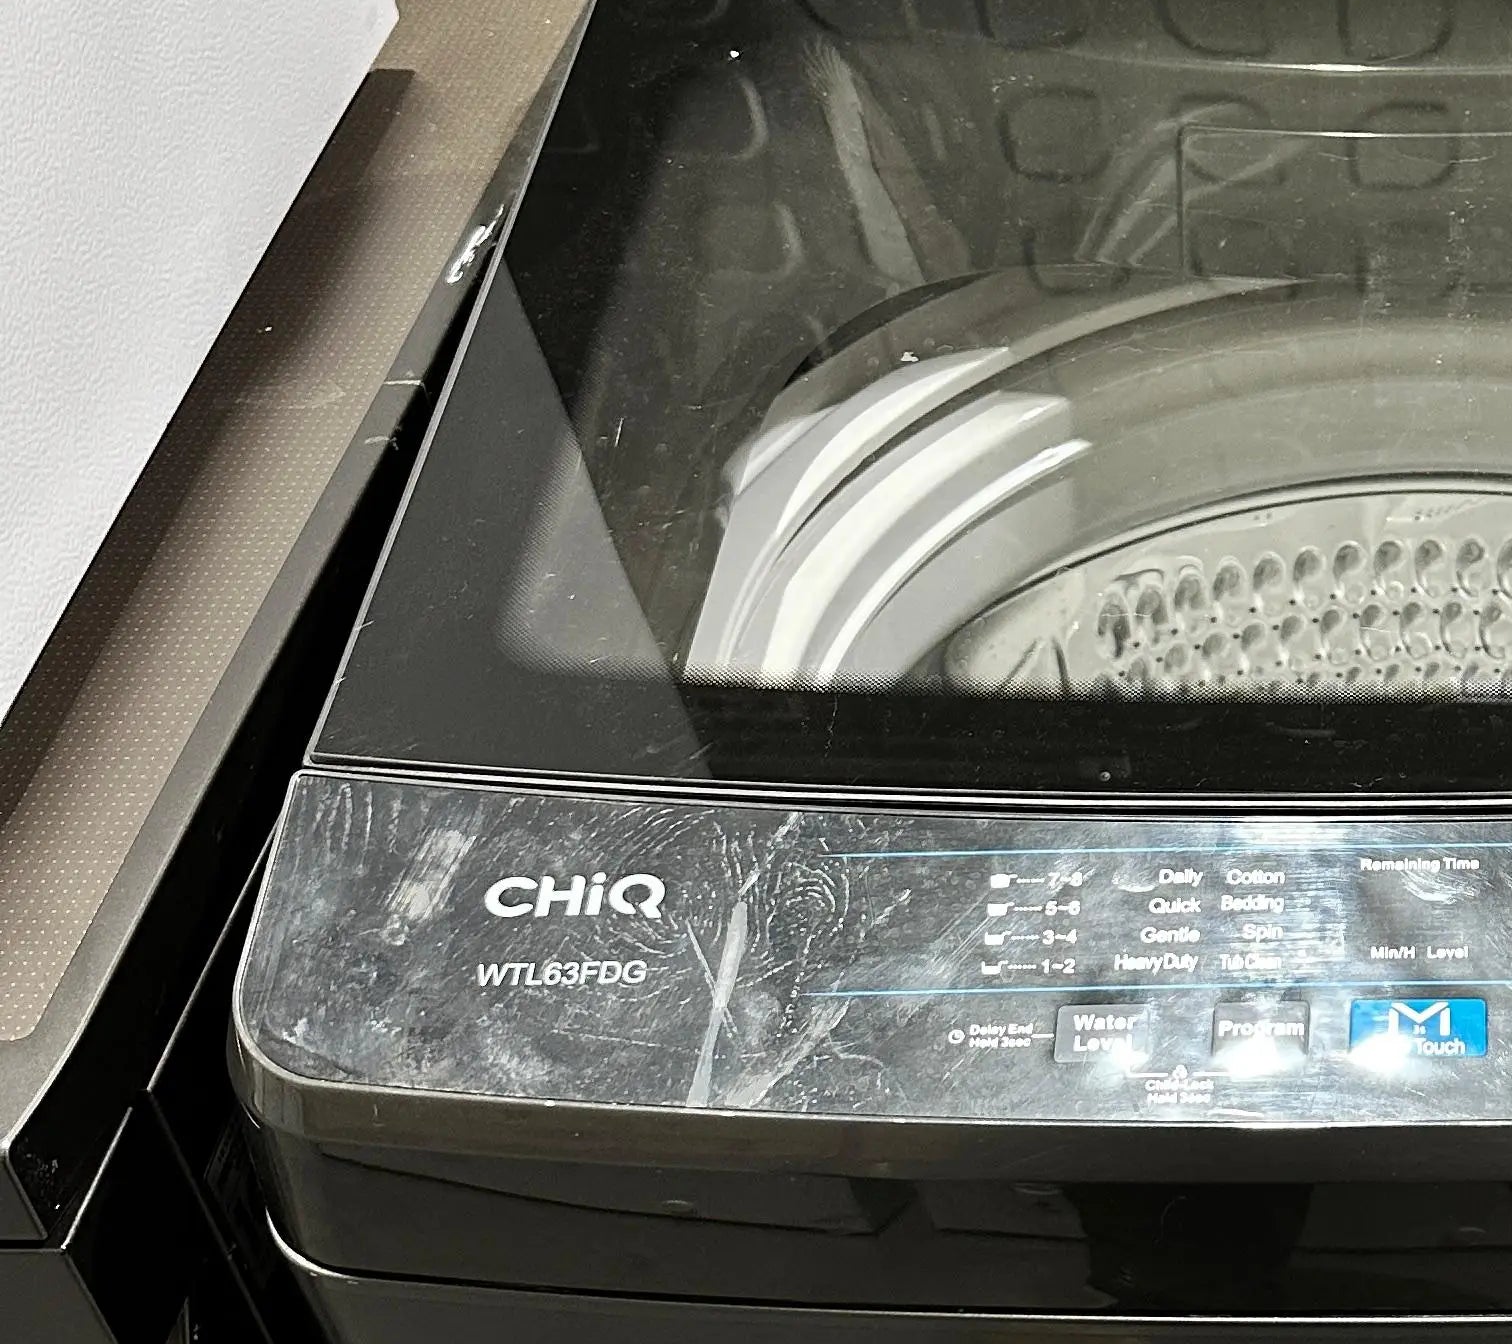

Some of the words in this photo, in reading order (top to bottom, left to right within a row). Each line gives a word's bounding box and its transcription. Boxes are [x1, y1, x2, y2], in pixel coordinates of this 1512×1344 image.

[1360, 857, 1441, 873] Remaining
[1442, 856, 1480, 871] Time
[1159, 868, 1203, 887] Daily
[1226, 869, 1286, 885] Cotton
[484, 871, 666, 918] CHiQ
[1149, 897, 1201, 913] Quick
[1221, 894, 1285, 914] Bedding
[1140, 927, 1200, 943] Gentle
[1242, 923, 1284, 943] Spin
[1426, 945, 1469, 960] Level
[477, 960, 648, 986] WTL63FDG
[969, 1023, 1006, 1037] Delay
[1008, 1023, 1034, 1035] End
[1073, 1014, 1137, 1032] Water
[1218, 1020, 1305, 1041] Program
[969, 1036, 999, 1049] Hold
[1073, 1034, 1134, 1053] Level
[1416, 1037, 1466, 1055] Touch
